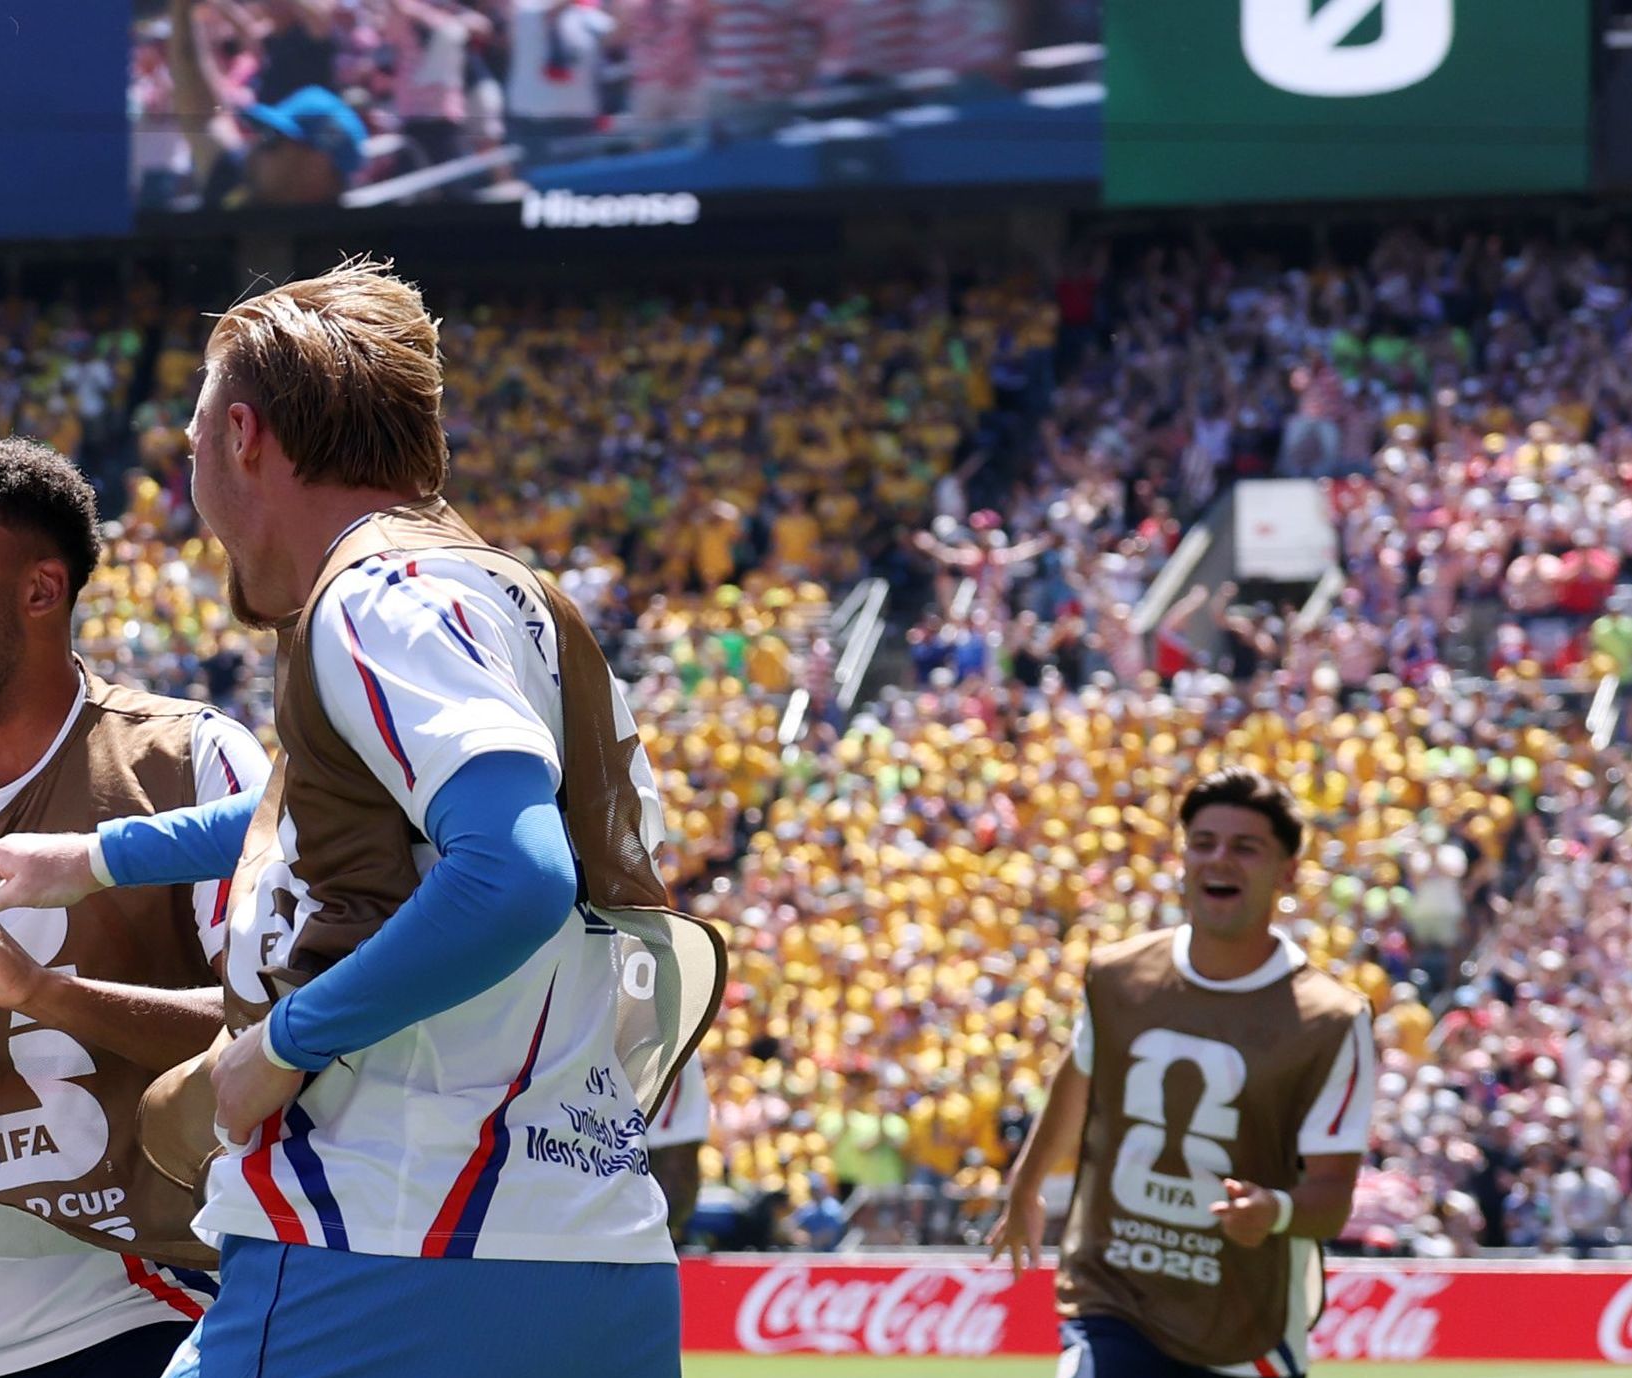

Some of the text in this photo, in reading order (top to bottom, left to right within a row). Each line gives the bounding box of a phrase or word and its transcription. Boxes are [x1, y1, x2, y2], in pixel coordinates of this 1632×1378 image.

[520, 188, 701, 229] Hisense
[57, 1186, 126, 1219] CUP
[1144, 1179, 1197, 1210] FIFA
[1103, 1239, 1222, 1286] 2026
